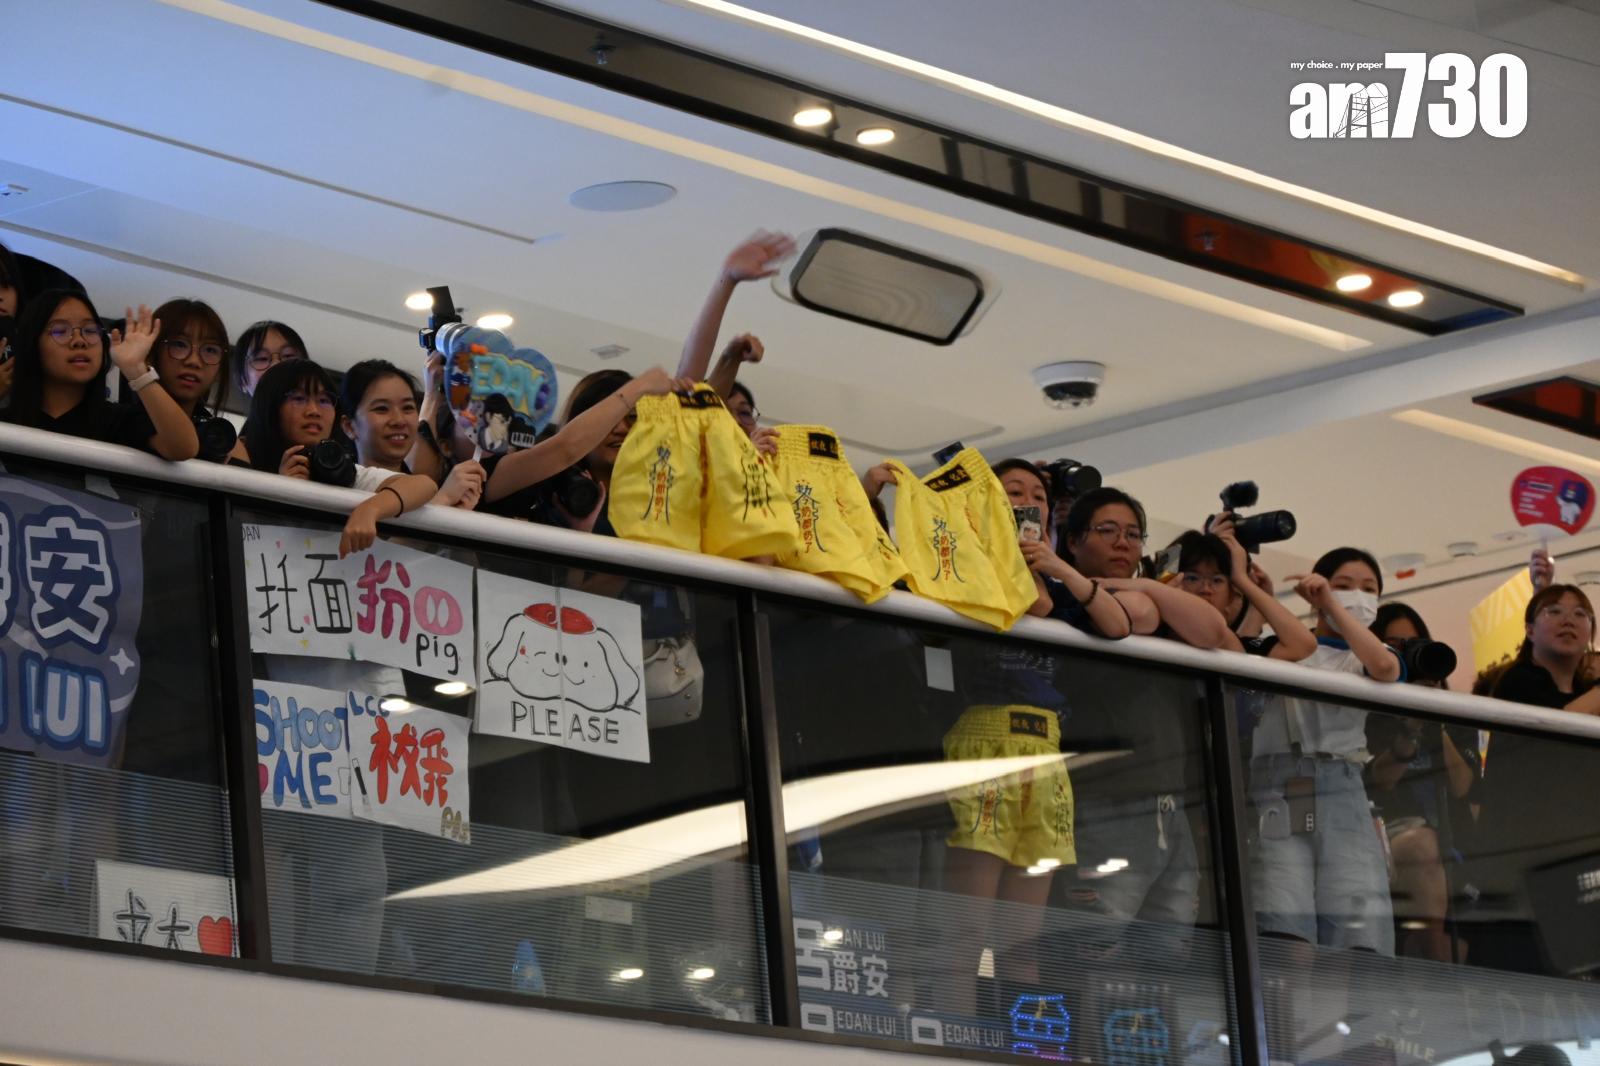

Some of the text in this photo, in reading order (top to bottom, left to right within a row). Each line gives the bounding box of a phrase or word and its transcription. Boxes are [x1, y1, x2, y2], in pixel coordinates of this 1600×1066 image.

[471, 355, 545, 414] EDAN
[0, 508, 116, 648] 安
[510, 701, 620, 745] PLEASE
[273, 750, 338, 809] ME
[835, 1009, 873, 1033] EDAN
[876, 1015, 897, 1037] LUI
[945, 1023, 980, 1044] EDAN
[983, 1028, 1005, 1048] LUI
